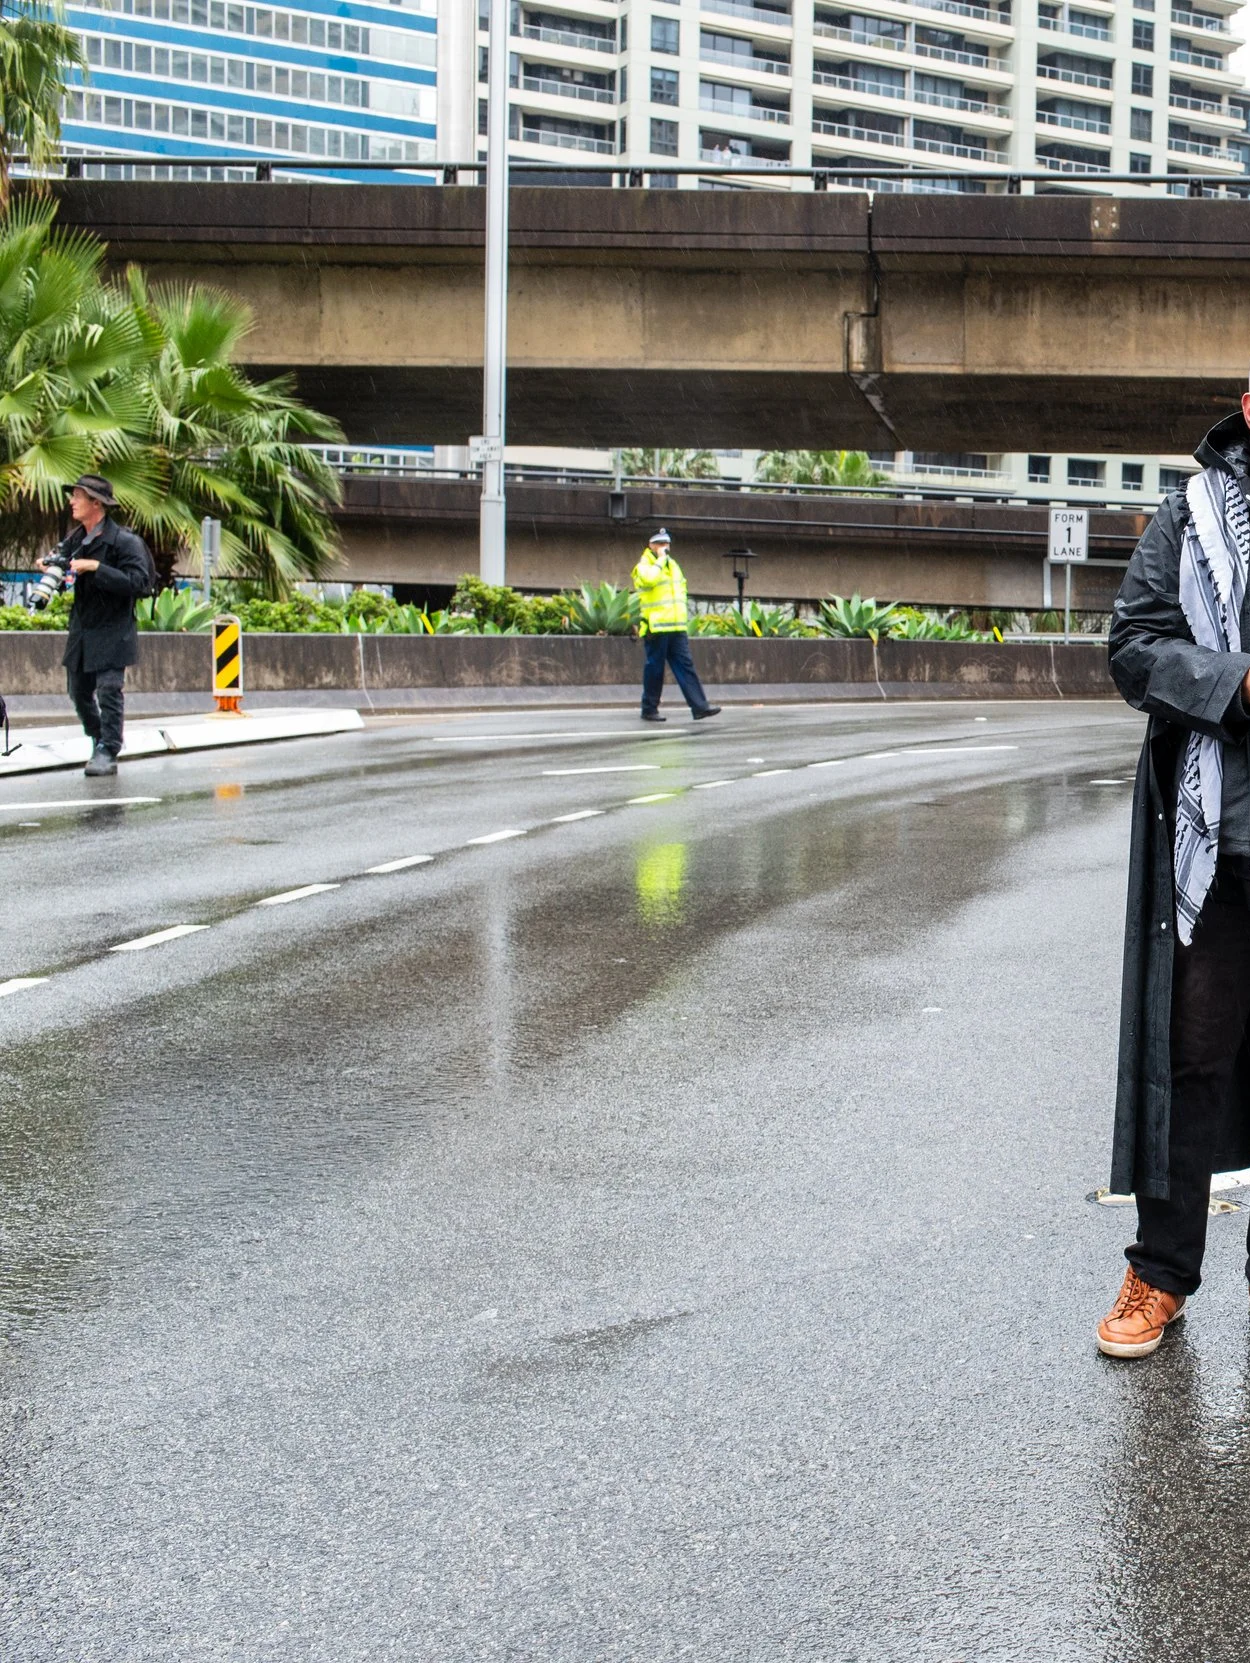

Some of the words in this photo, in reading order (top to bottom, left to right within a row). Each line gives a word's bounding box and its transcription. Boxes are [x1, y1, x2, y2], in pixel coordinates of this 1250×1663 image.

[1054, 513, 1083, 523] FORM
[1066, 526, 1071, 544] 1
[1053, 547, 1082, 557] LANE
